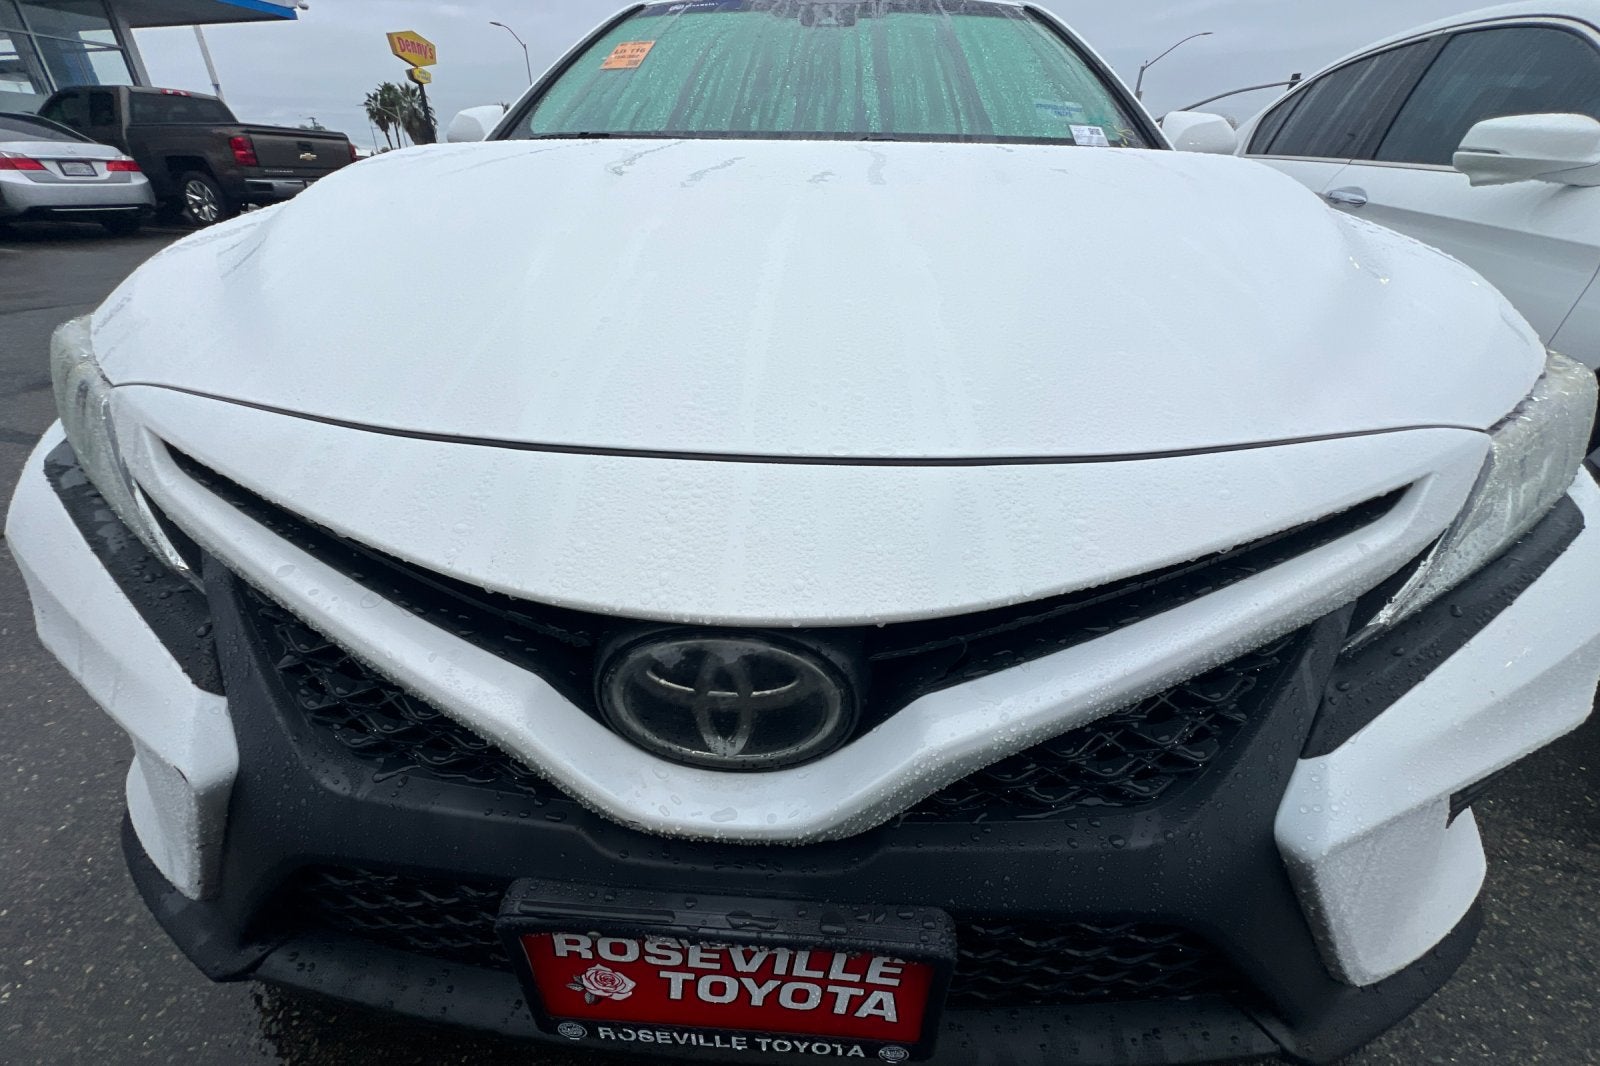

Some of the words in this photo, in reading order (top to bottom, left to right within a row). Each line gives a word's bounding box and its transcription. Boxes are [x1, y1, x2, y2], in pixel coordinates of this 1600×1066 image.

[397, 36, 433, 60] Denny's
[552, 933, 908, 987] ROSEVILLE
[659, 970, 899, 1023] TOYOTA
[598, 1027, 749, 1051] ROSEVILLE
[760, 1038, 866, 1059] TOYOTA
